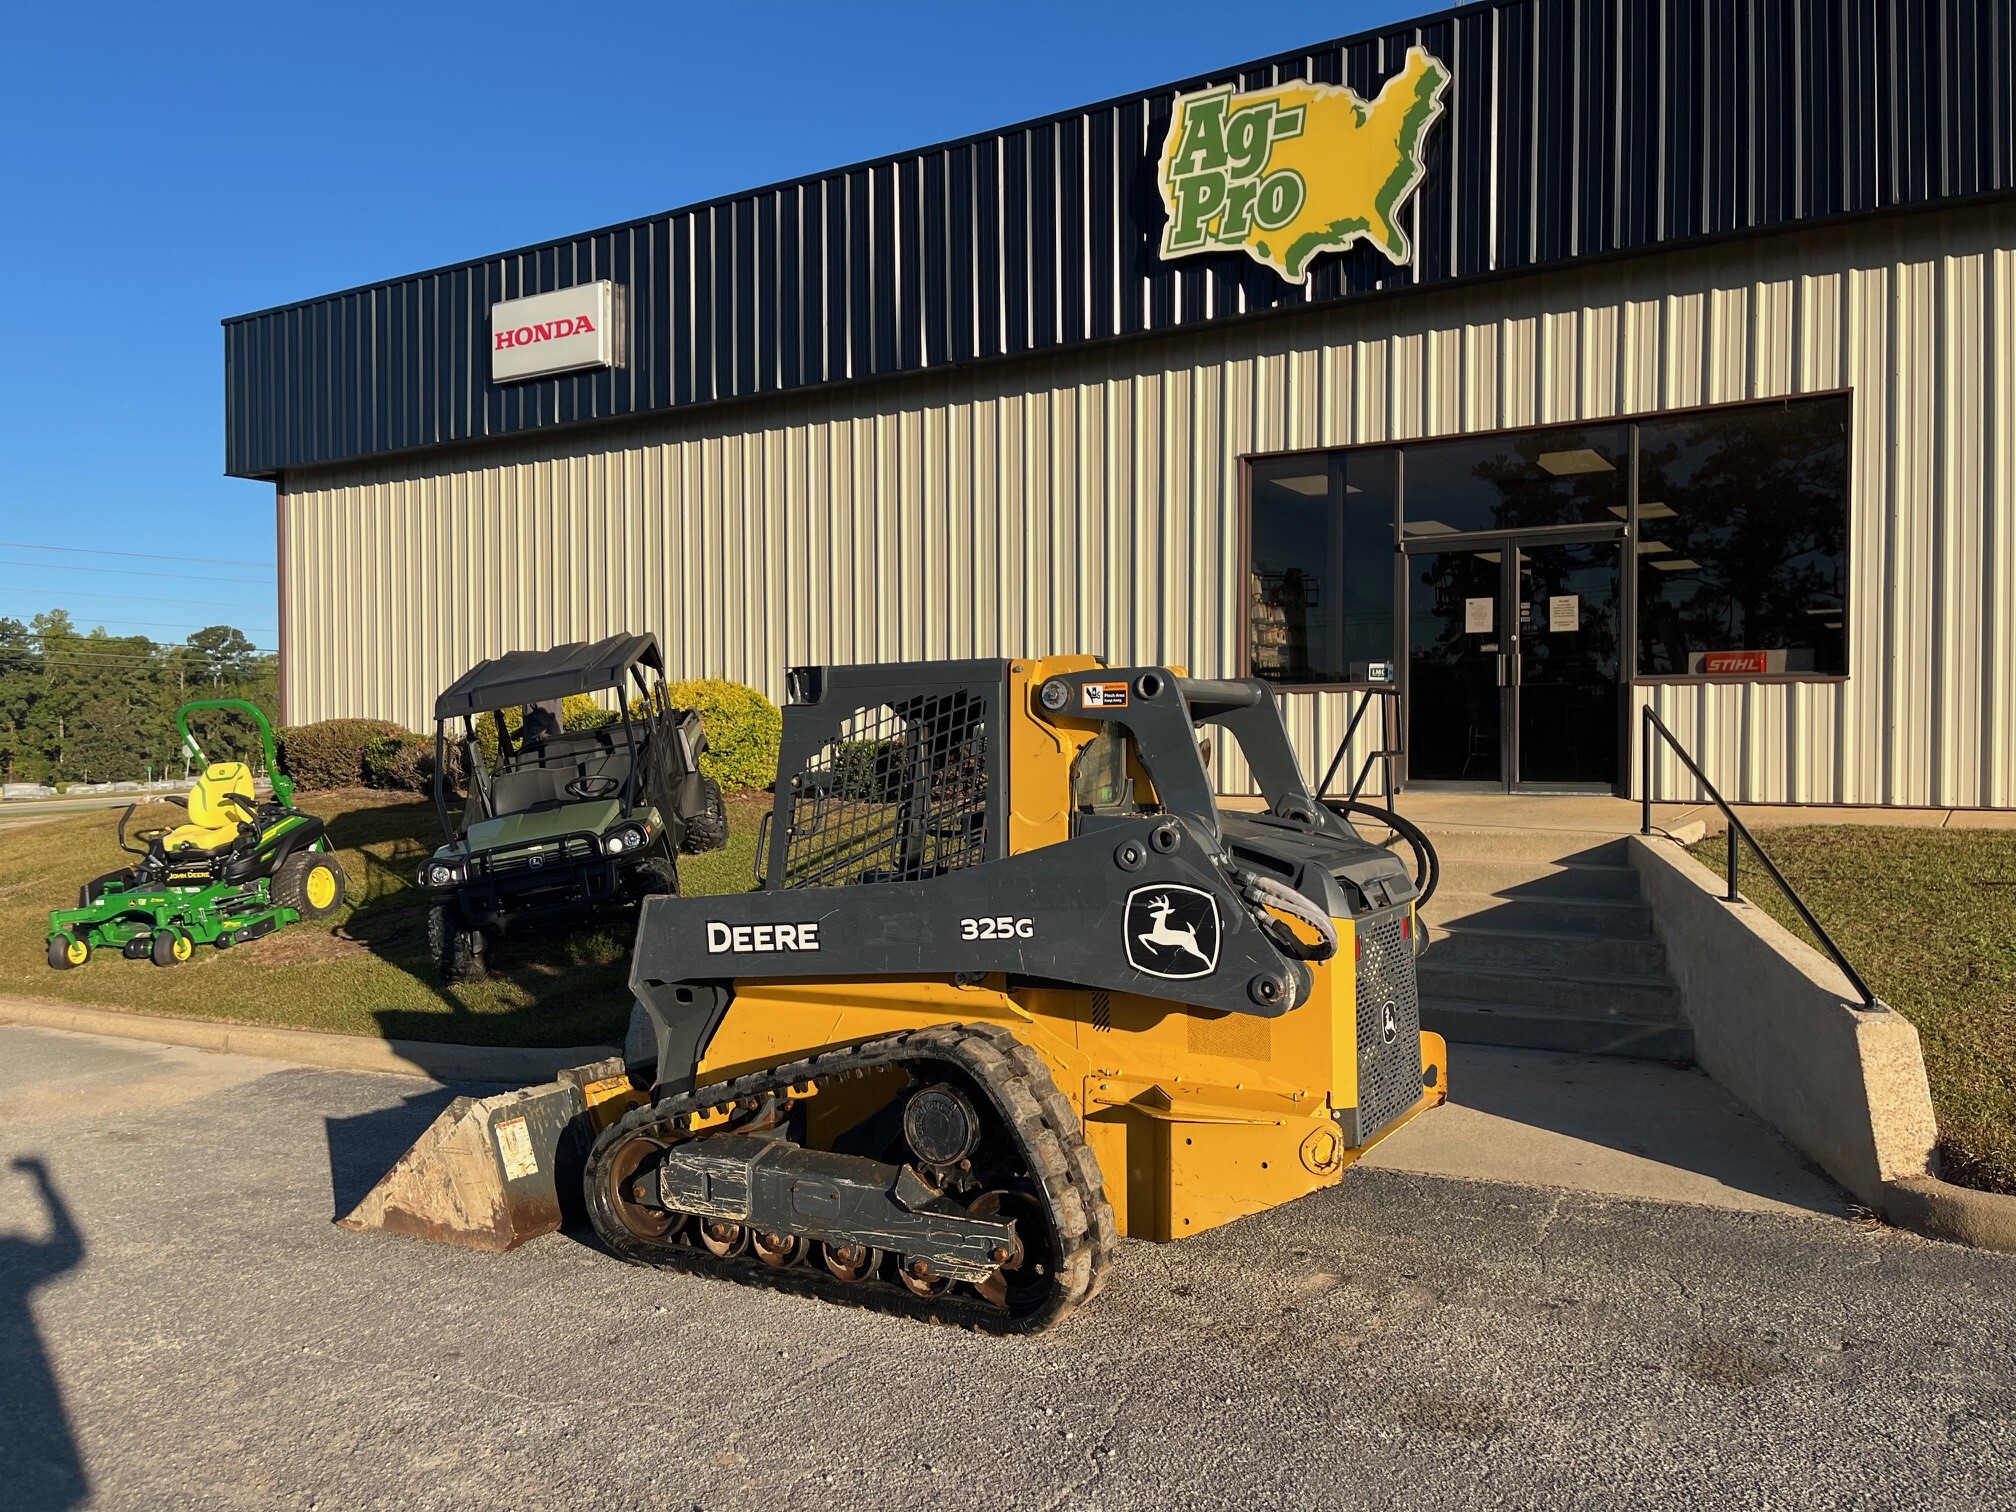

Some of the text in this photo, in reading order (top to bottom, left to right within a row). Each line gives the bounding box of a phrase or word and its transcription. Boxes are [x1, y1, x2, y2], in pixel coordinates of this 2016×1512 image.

[1167, 92, 1306, 184] Ag-
[1167, 169, 1306, 252] Pro
[495, 315, 595, 350] HONDA
[1707, 659, 1759, 671] STIHL
[706, 921, 820, 953] DEERE
[960, 916, 1034, 940] 325G
